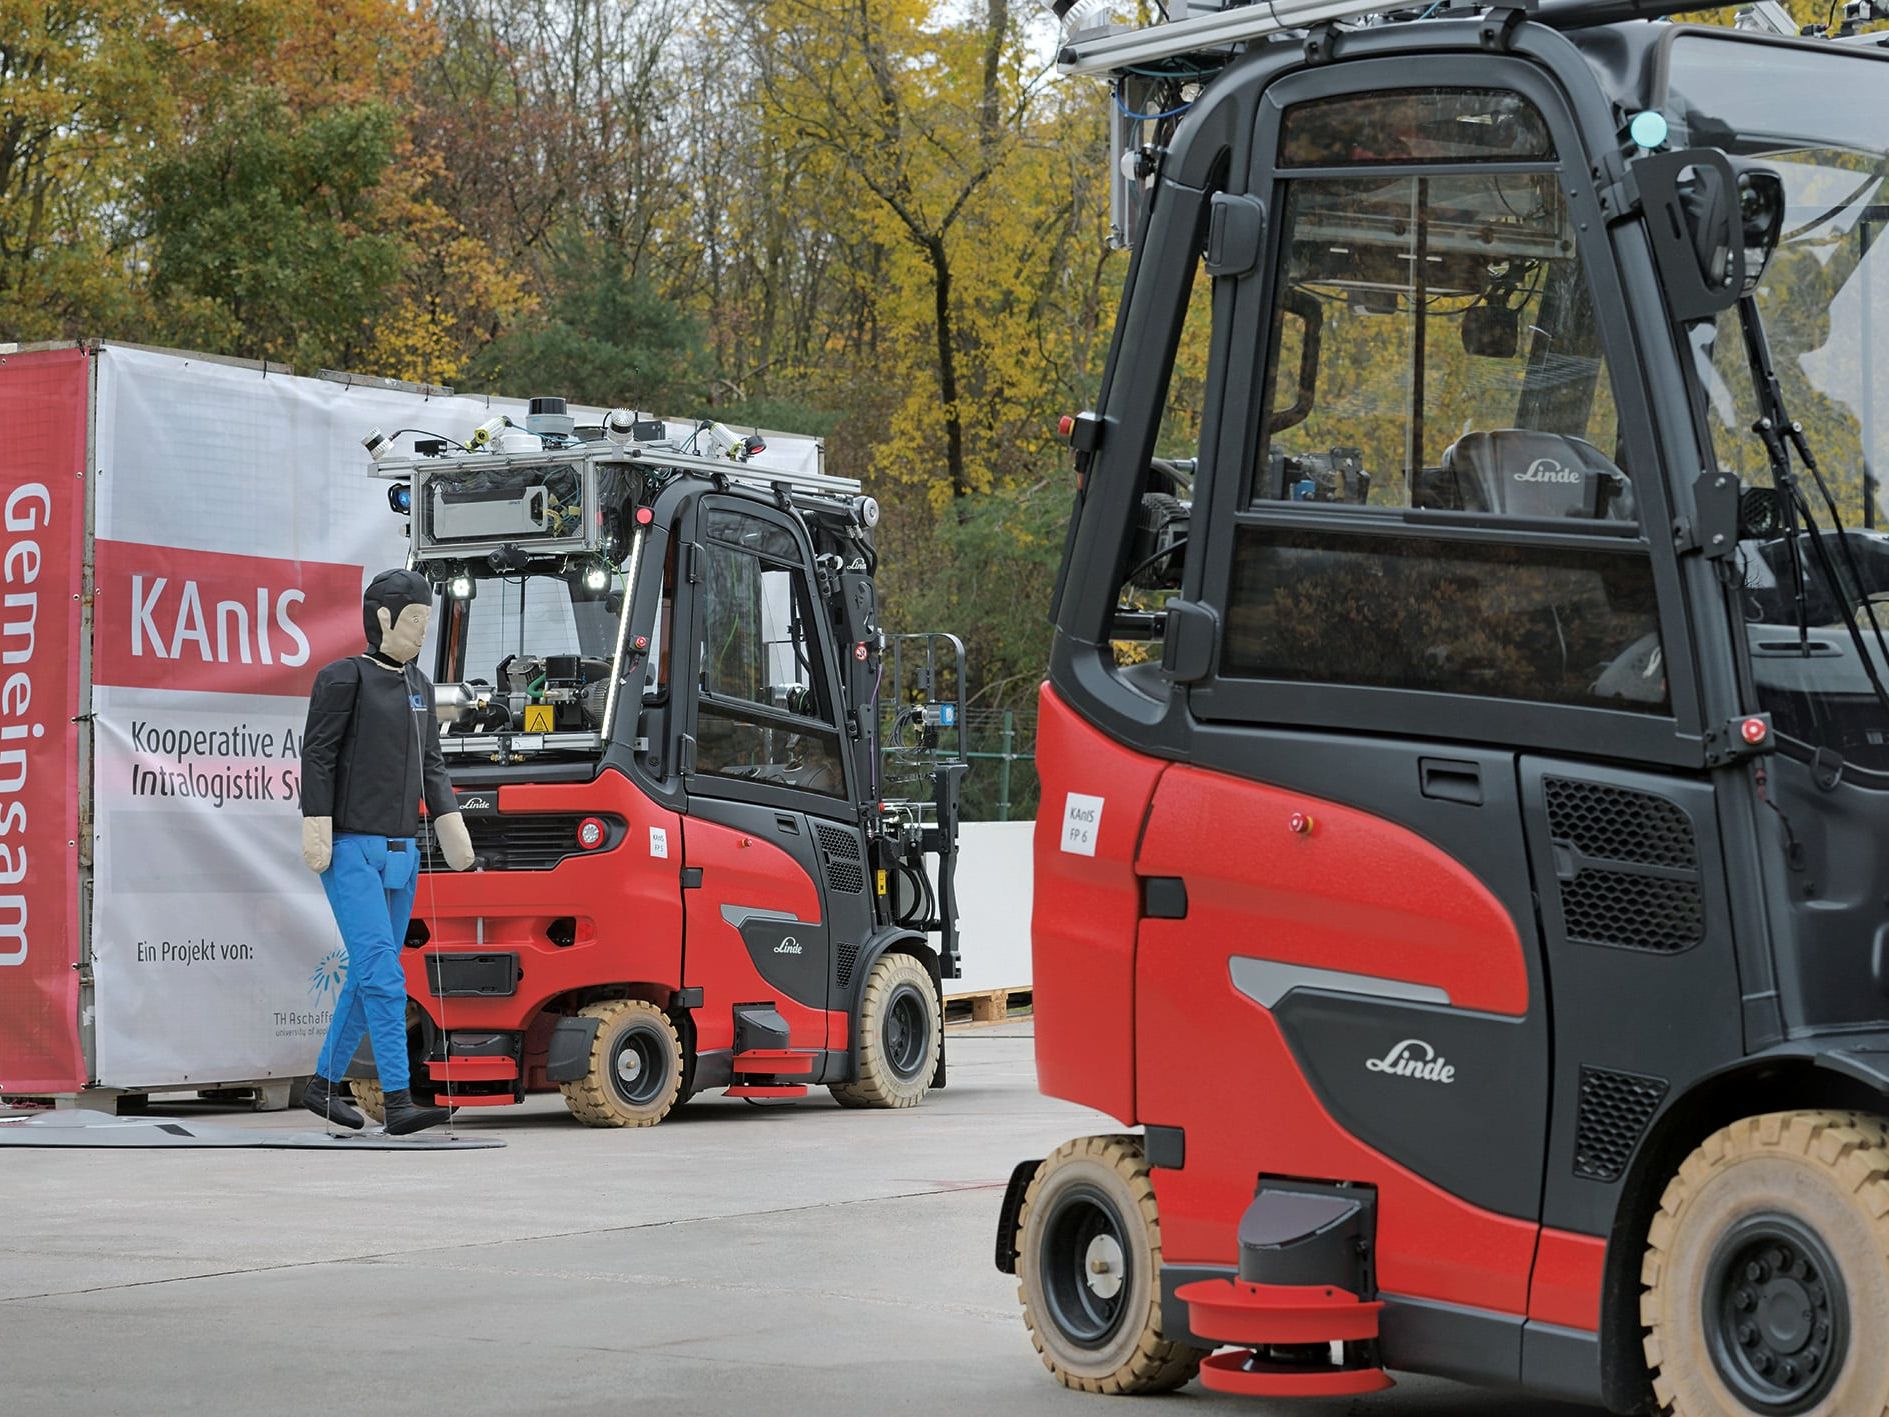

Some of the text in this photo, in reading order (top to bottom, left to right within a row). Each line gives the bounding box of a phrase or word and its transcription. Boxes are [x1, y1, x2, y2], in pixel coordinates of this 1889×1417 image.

[1513, 458, 1580, 483] Linde
[130, 575, 312, 667] KAnIS
[0, 483, 52, 967] Gemeinsam
[131, 721, 274, 764] Kooperative
[131, 763, 275, 808] Intralogistik
[459, 797, 490, 809] Linde
[1070, 807, 1096, 823] KAnIS
[1070, 828, 1088, 843] FP 6
[137, 938, 253, 966] Ein Projekt von:
[773, 936, 803, 954] Linde
[273, 1012, 287, 1025] TH
[1365, 1039, 1455, 1083] Linde
